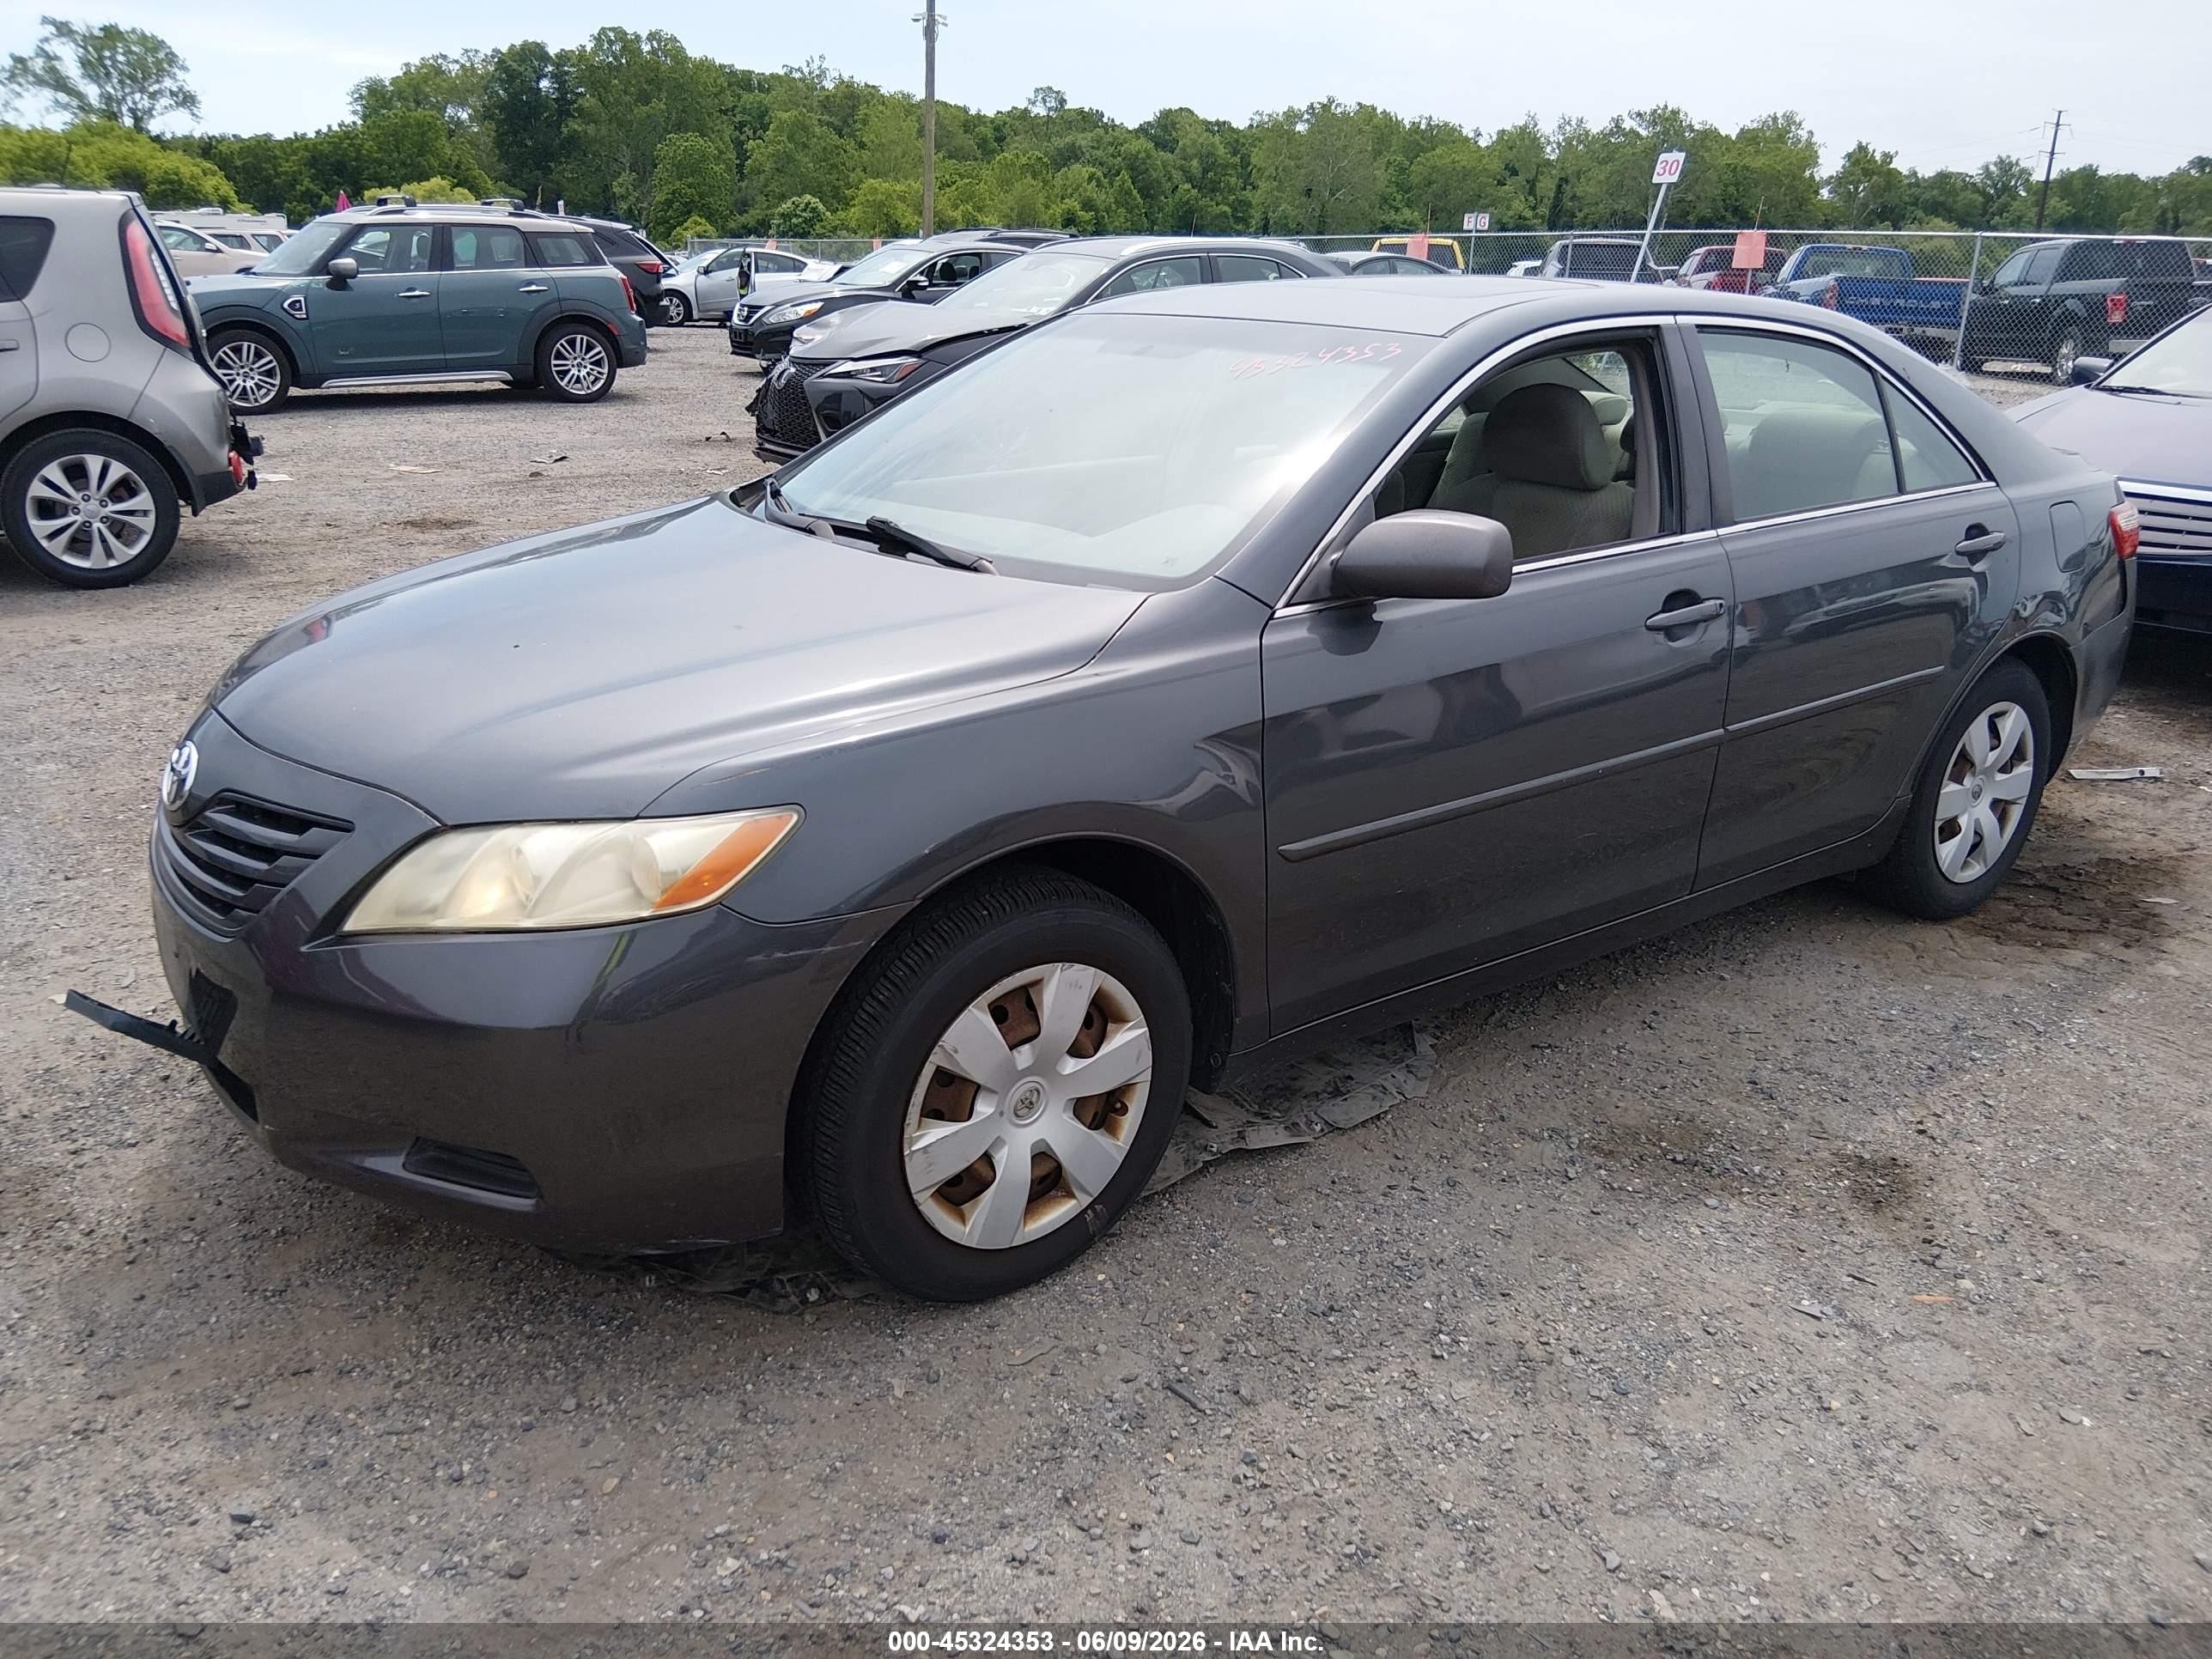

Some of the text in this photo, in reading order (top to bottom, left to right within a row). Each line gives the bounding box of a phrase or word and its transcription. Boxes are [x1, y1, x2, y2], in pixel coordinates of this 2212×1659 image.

[1656, 159, 1680, 177] 30
[1467, 216, 1474, 228] F
[1479, 216, 1486, 228] G
